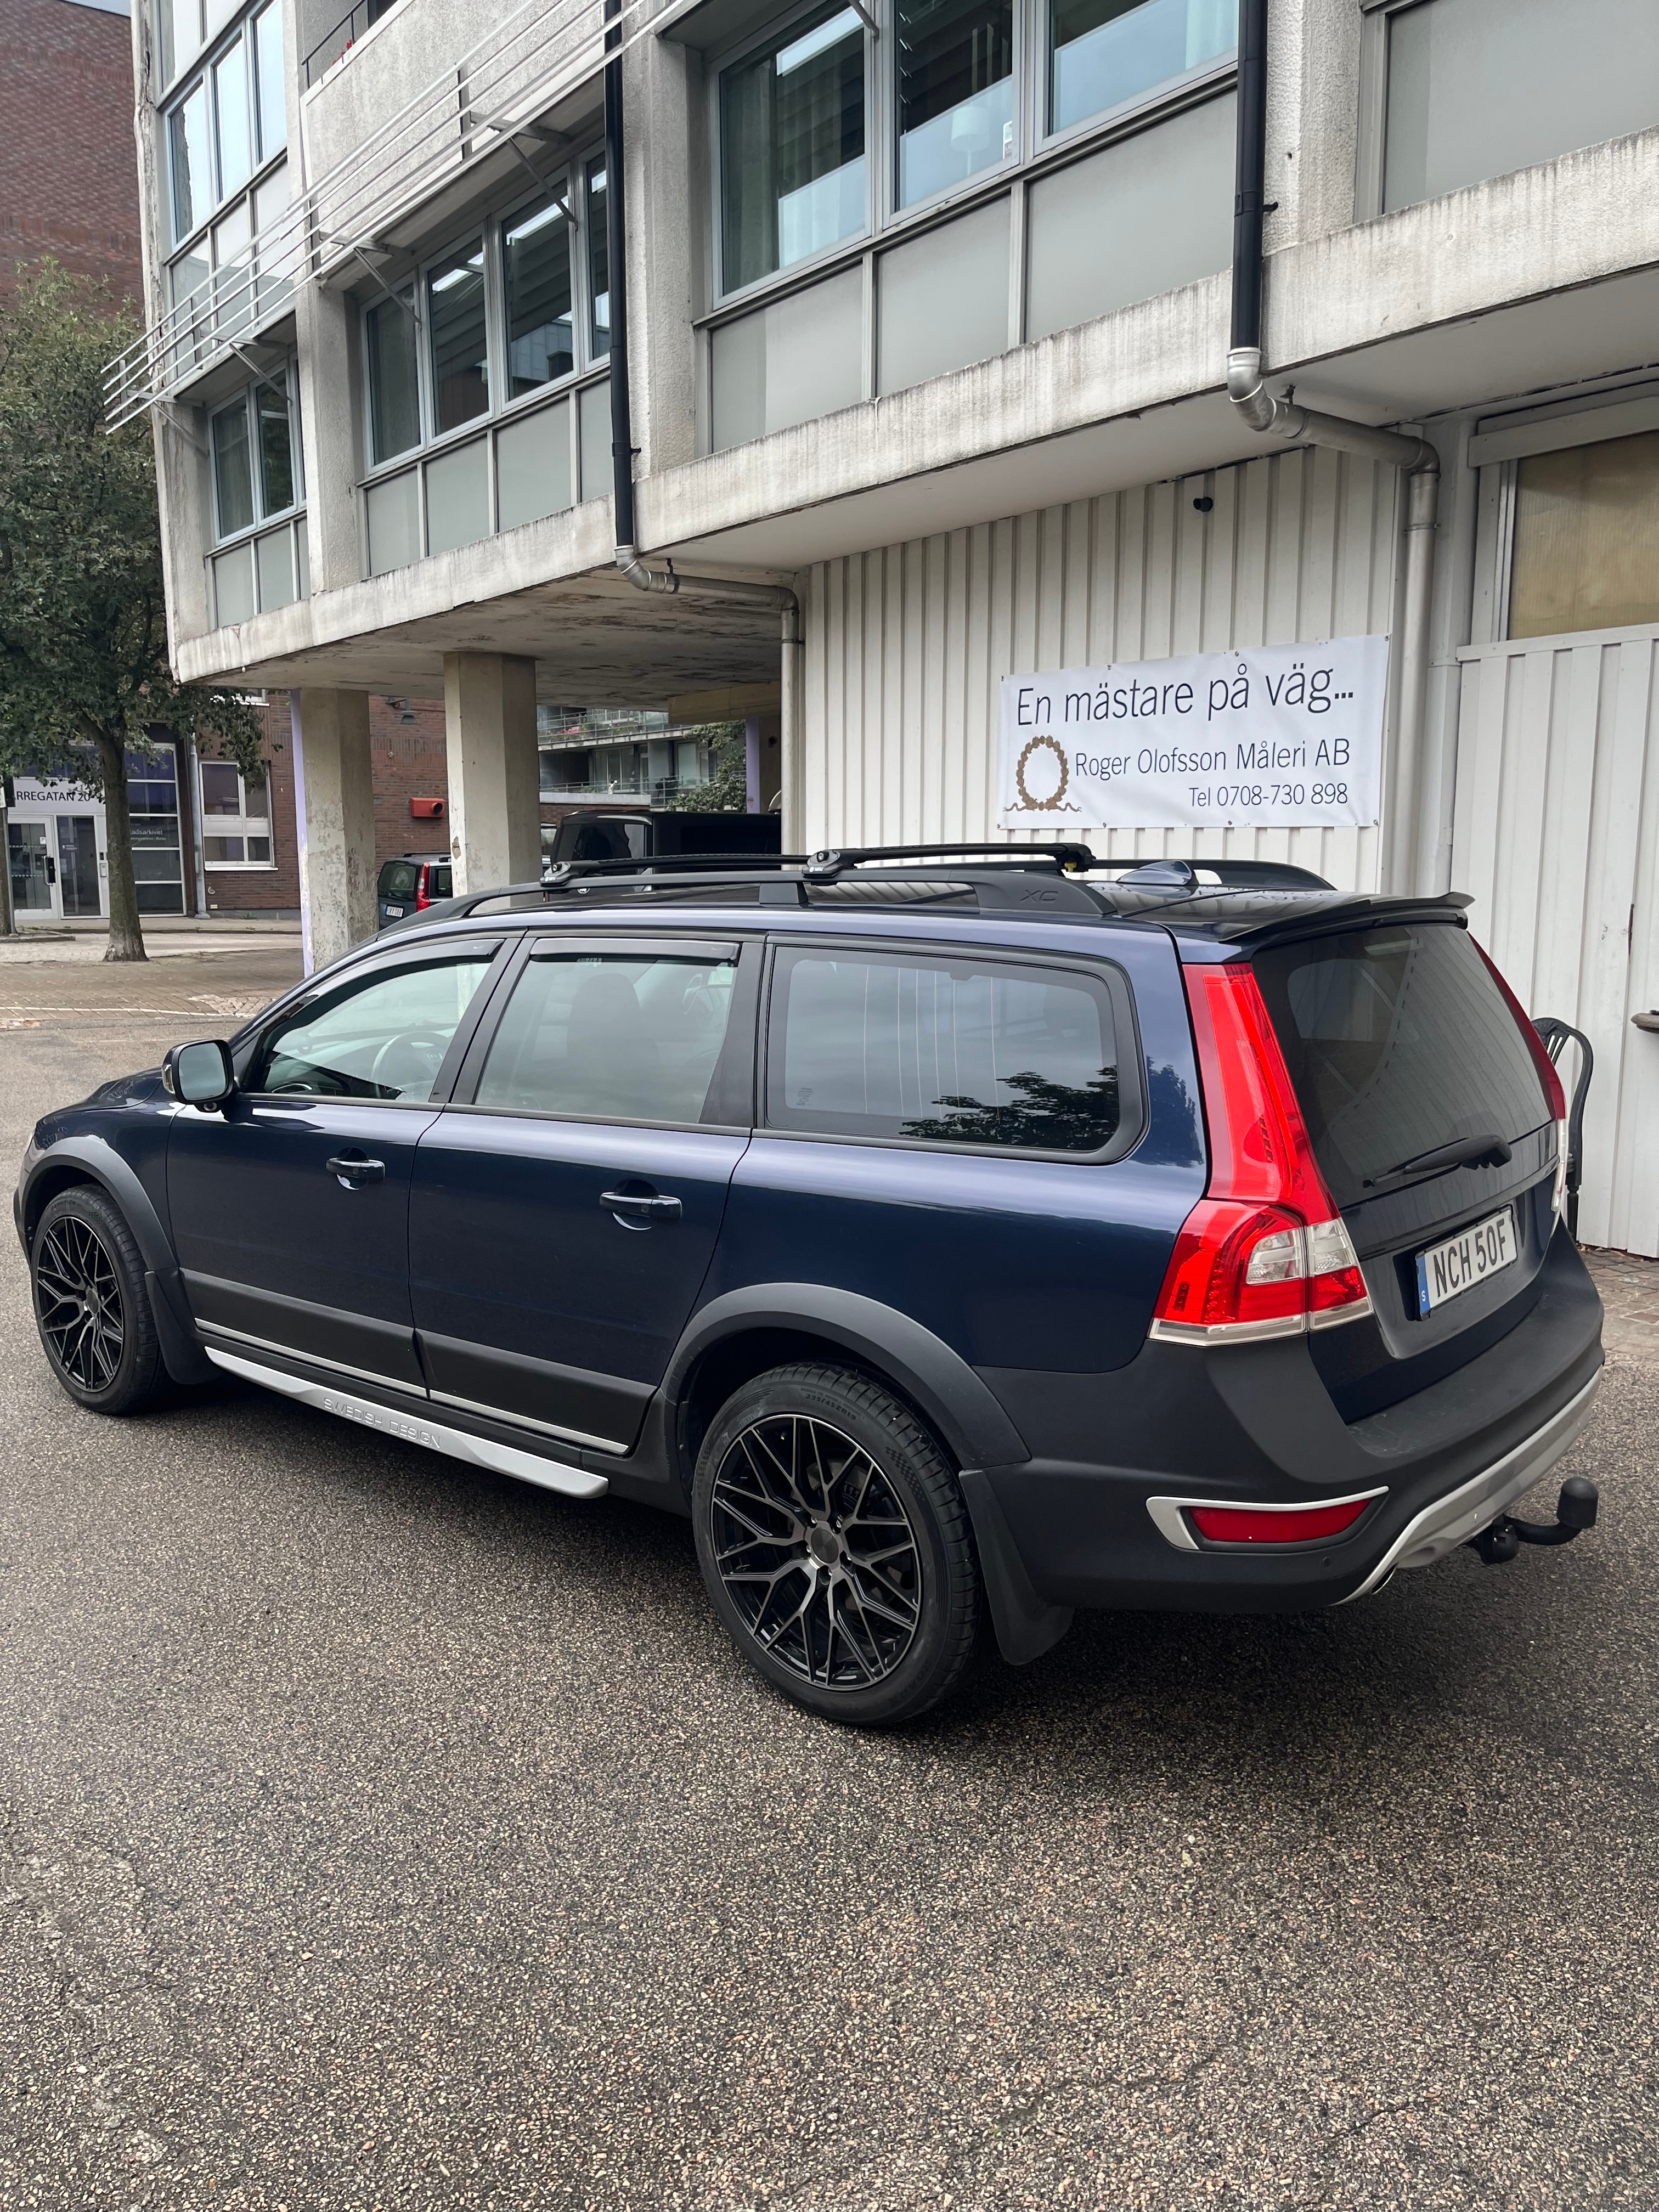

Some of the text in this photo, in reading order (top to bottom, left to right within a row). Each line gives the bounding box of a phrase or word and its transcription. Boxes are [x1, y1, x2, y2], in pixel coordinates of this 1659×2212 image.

[1017, 662, 1354, 726] En mästare på väg...
[1076, 738, 1350, 781] Roger Olofsson Måleri AB
[15, 791, 90, 802] RREGATAN 20
[1189, 783, 1348, 806] Tel 0708-730 898
[1020, 889, 1058, 903] XC
[1433, 1218, 1505, 1297] NCH 50F
[1421, 1290, 1426, 1302] S
[324, 1397, 440, 1449] SWEDISH DESIGN
